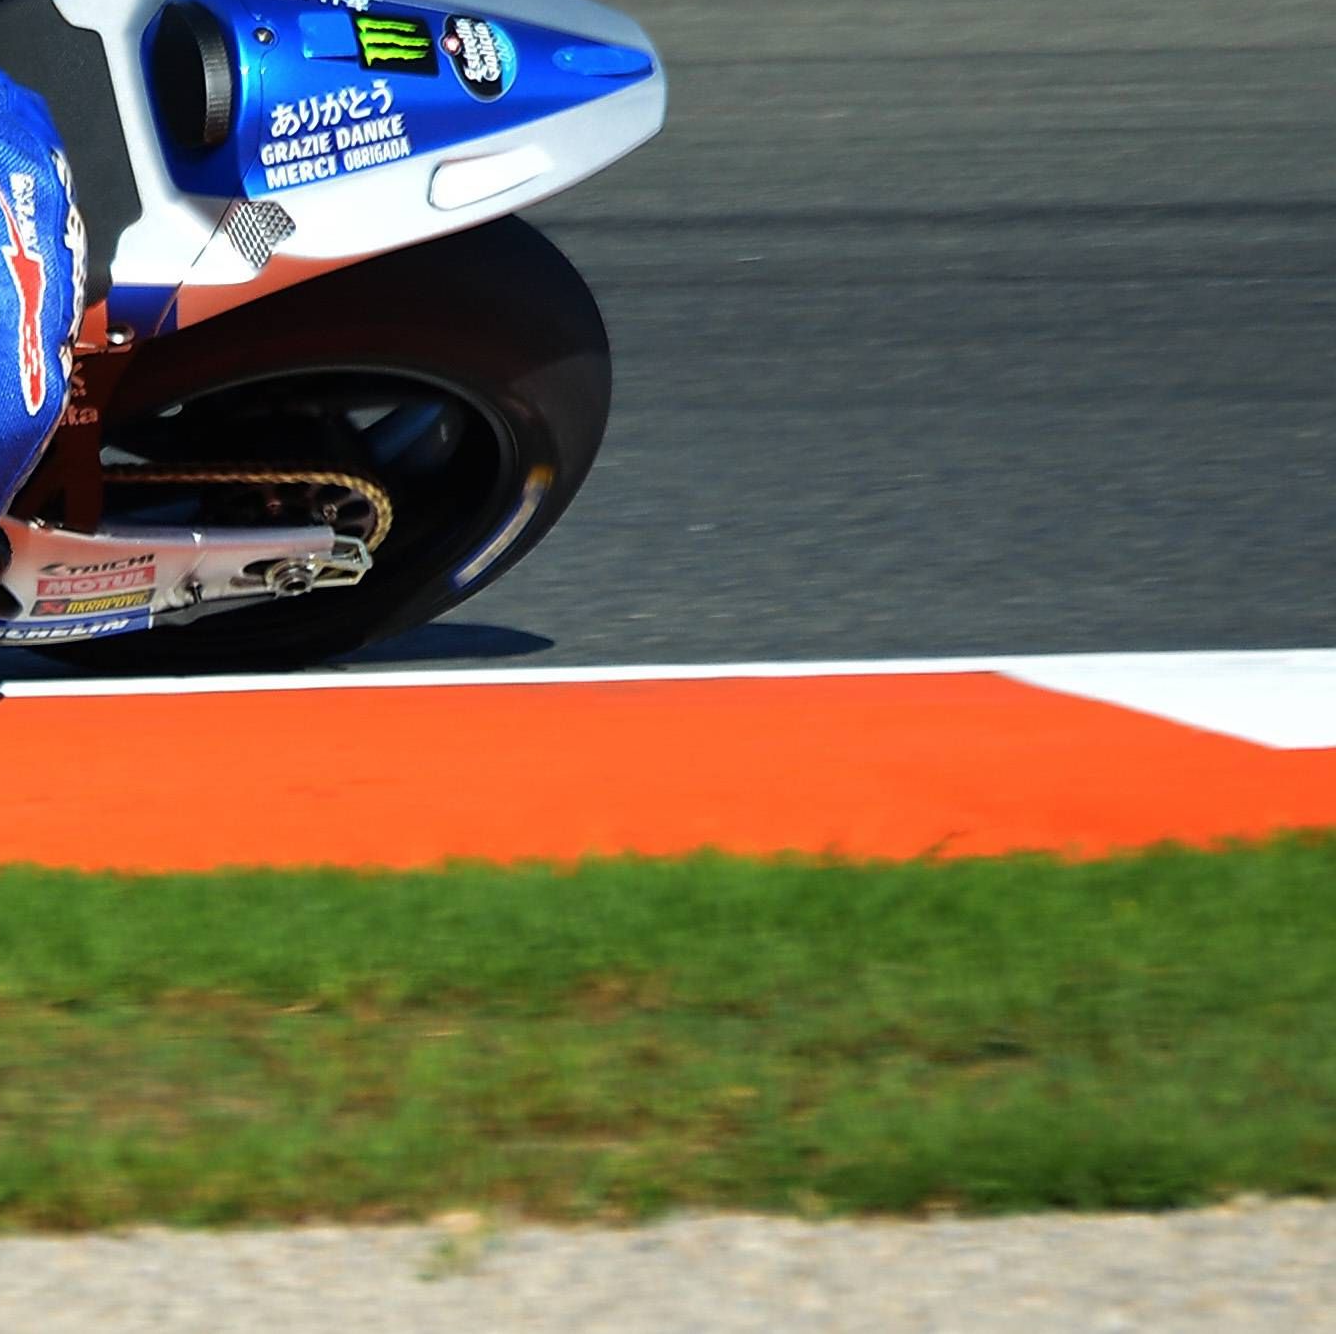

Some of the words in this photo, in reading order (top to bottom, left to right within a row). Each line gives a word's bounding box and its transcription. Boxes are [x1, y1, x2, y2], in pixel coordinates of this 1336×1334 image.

[270, 79, 394, 137] ありがとう
[261, 131, 334, 166] GRAZIE
[336, 114, 405, 150] DANKE
[265, 154, 337, 189] MERCI
[343, 136, 410, 171] OBRIGADA
[44, 572, 147, 596] MOTUL
[67, 554, 155, 574] TAICHI
